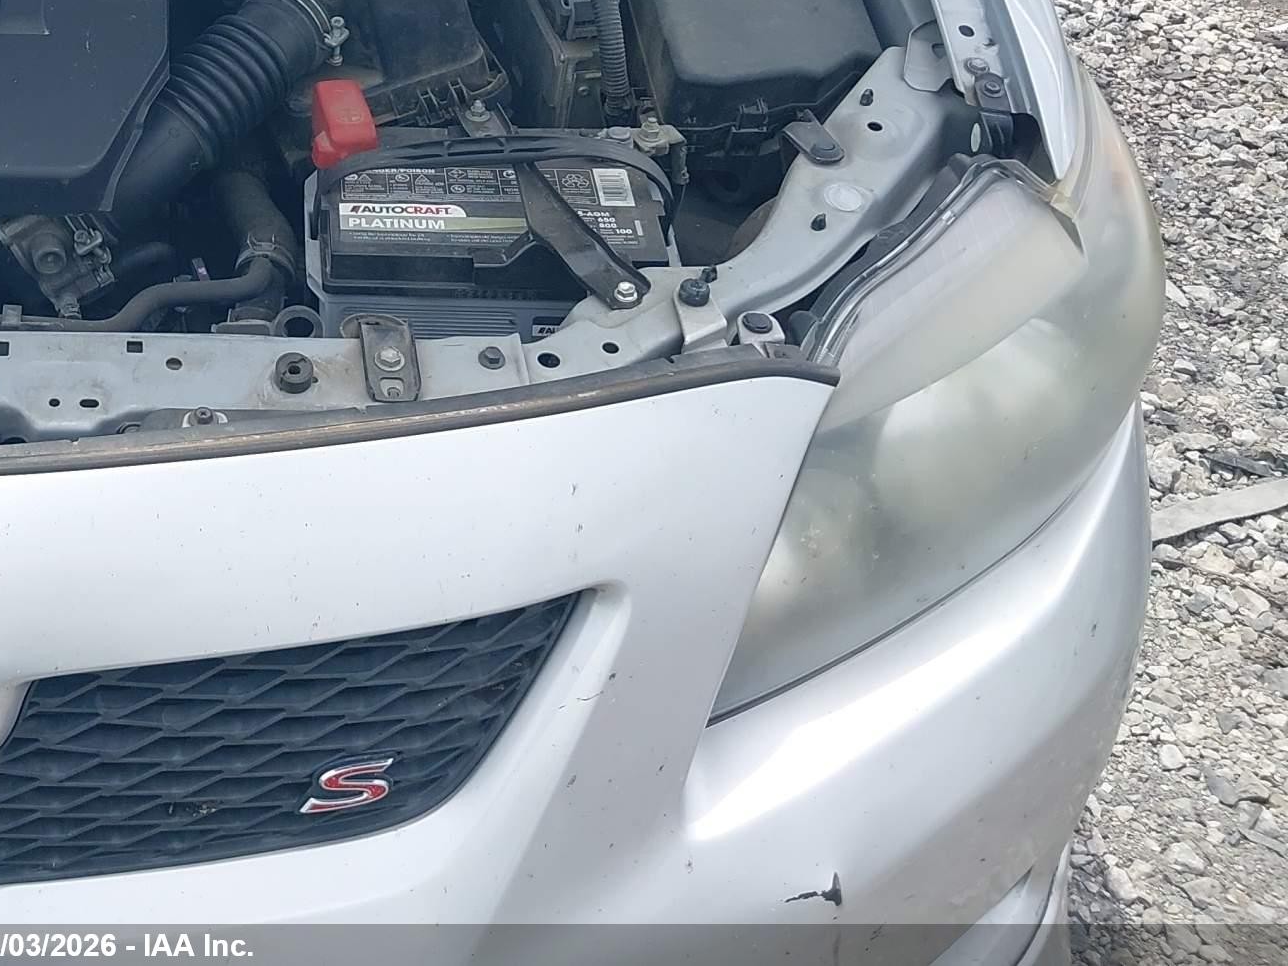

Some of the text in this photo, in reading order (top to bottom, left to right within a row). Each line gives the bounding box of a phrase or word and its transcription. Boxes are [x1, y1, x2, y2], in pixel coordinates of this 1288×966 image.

[359, 205, 452, 215] AUTOCRAFT
[348, 217, 446, 230] PLATINUM
[299, 757, 394, 814] S
